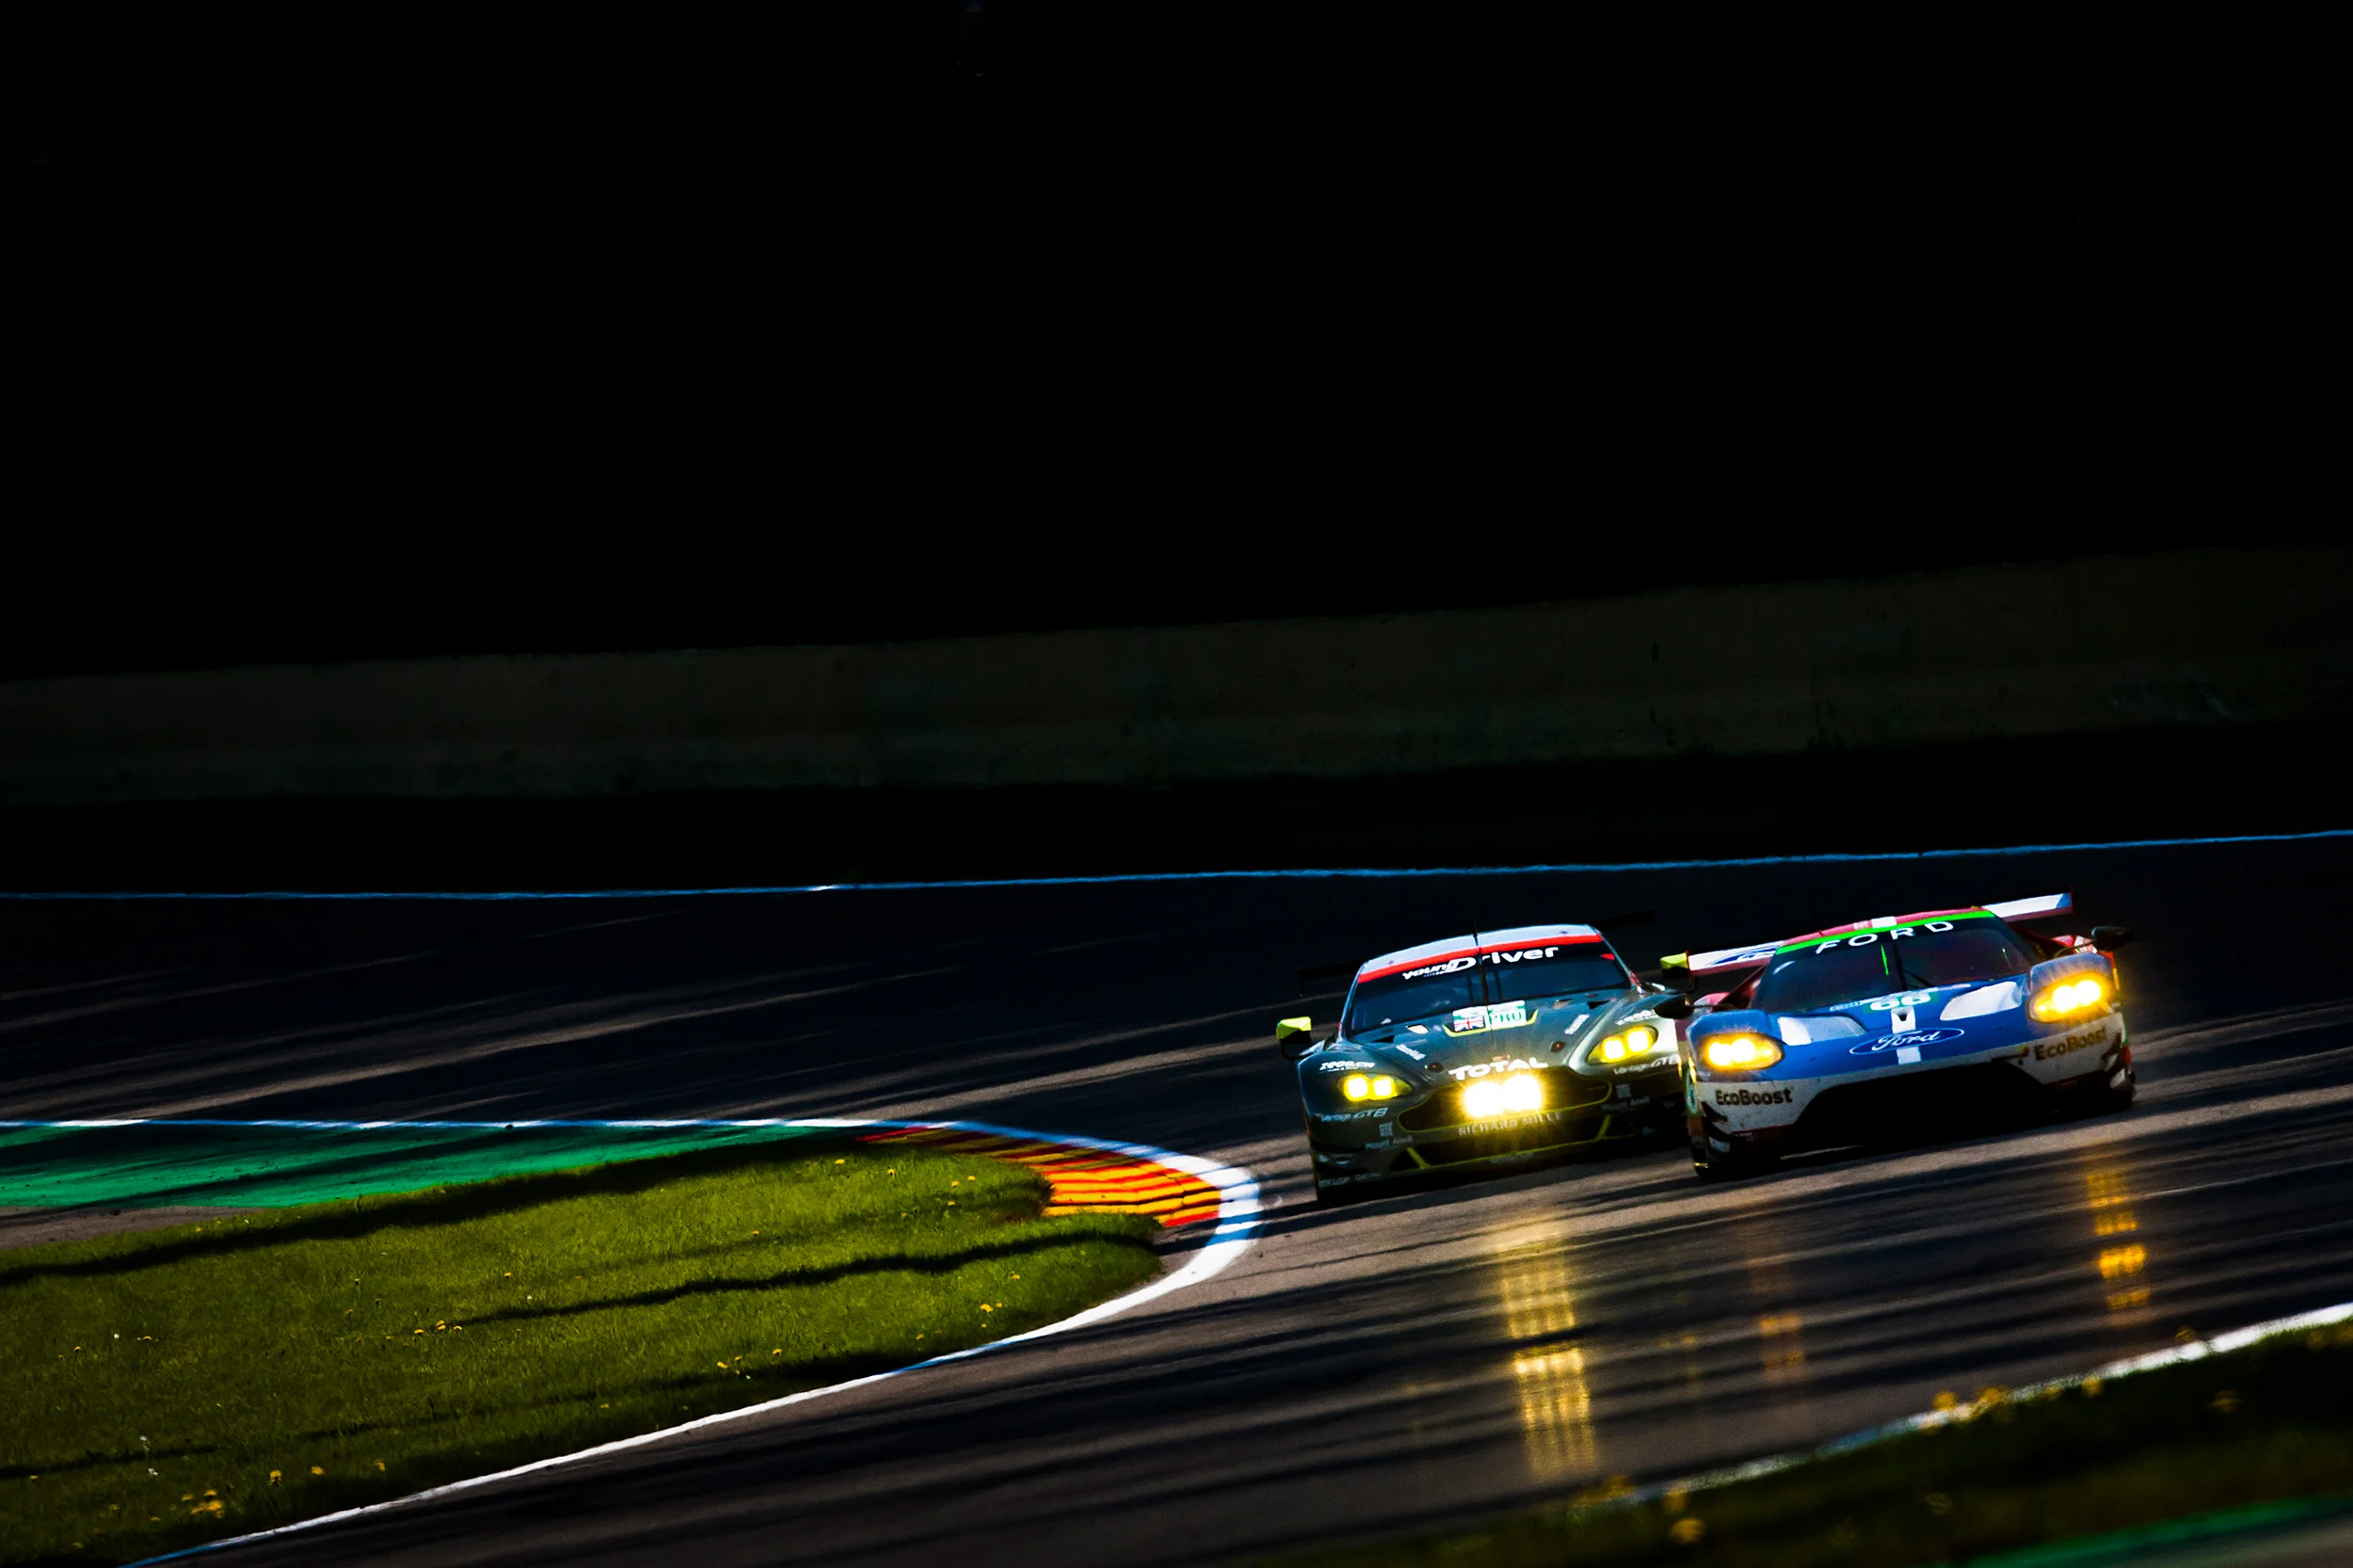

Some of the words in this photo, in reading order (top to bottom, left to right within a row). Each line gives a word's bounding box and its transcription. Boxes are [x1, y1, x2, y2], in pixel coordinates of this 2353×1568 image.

[1815, 921, 1954, 954] FORD
[1871, 1031, 1940, 1051] Ford
[1449, 1057, 1549, 1080] TOTAL
[1715, 1087, 1792, 1105] EcoBoost
[1458, 1117, 1518, 1136] RICHARD
